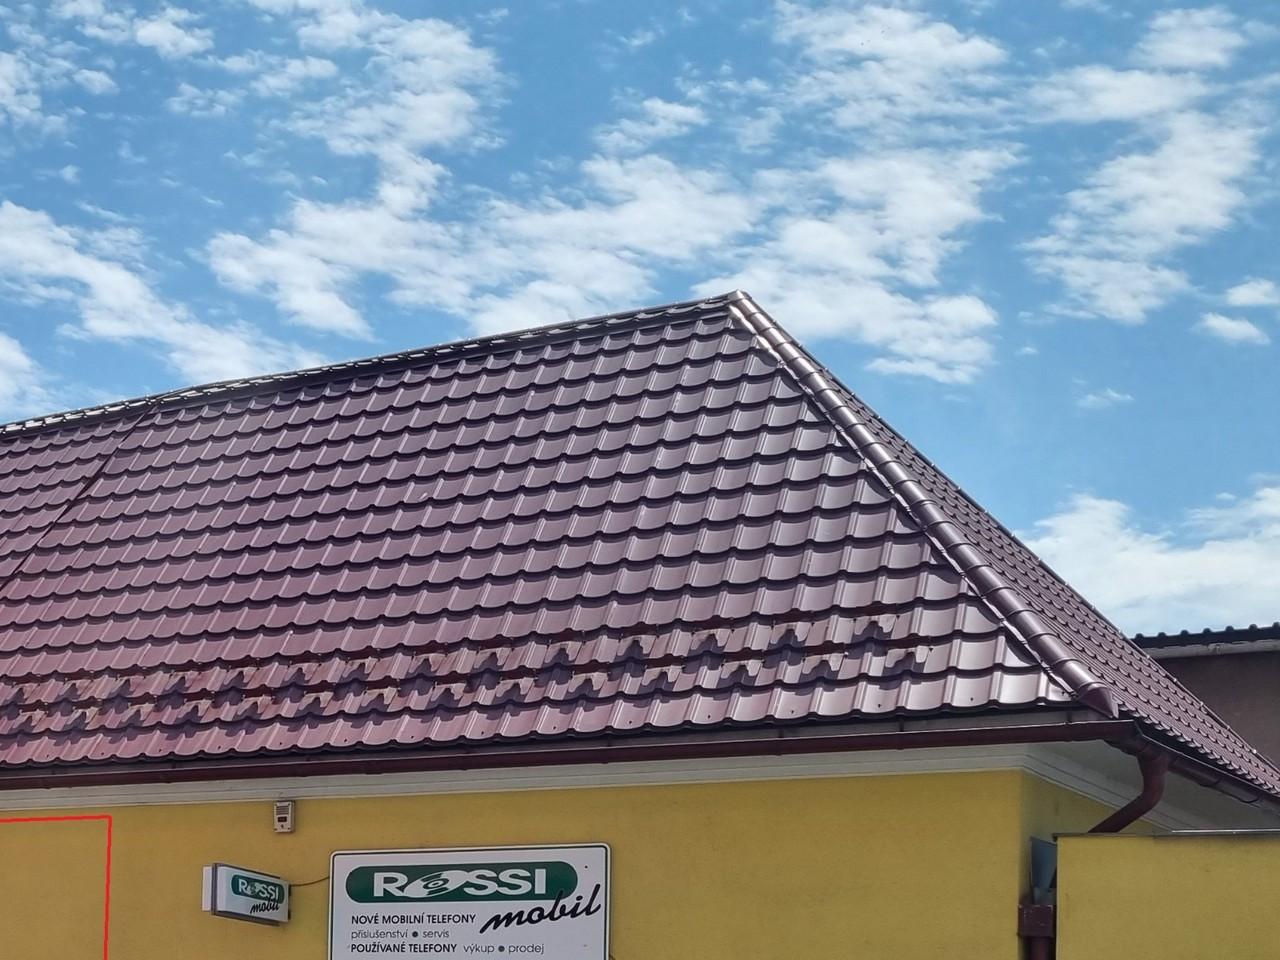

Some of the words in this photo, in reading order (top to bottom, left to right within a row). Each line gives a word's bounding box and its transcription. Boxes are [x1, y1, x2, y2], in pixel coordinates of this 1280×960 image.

[238, 878, 280, 901] ROSSI
[373, 868, 547, 898] ROSSI
[479, 883, 602, 934] mobil
[351, 912, 379, 925] NOVÉ
[381, 912, 424, 924] MOBILNÍ
[426, 914, 476, 924] TELEFONY
[351, 928, 409, 939] příslušenství
[422, 929, 450, 939] servis
[350, 941, 406, 953] POUŽÍVANÉ
[408, 943, 458, 953] TELEFONY
[463, 943, 495, 954] výkup
[508, 943, 545, 955] prodej
